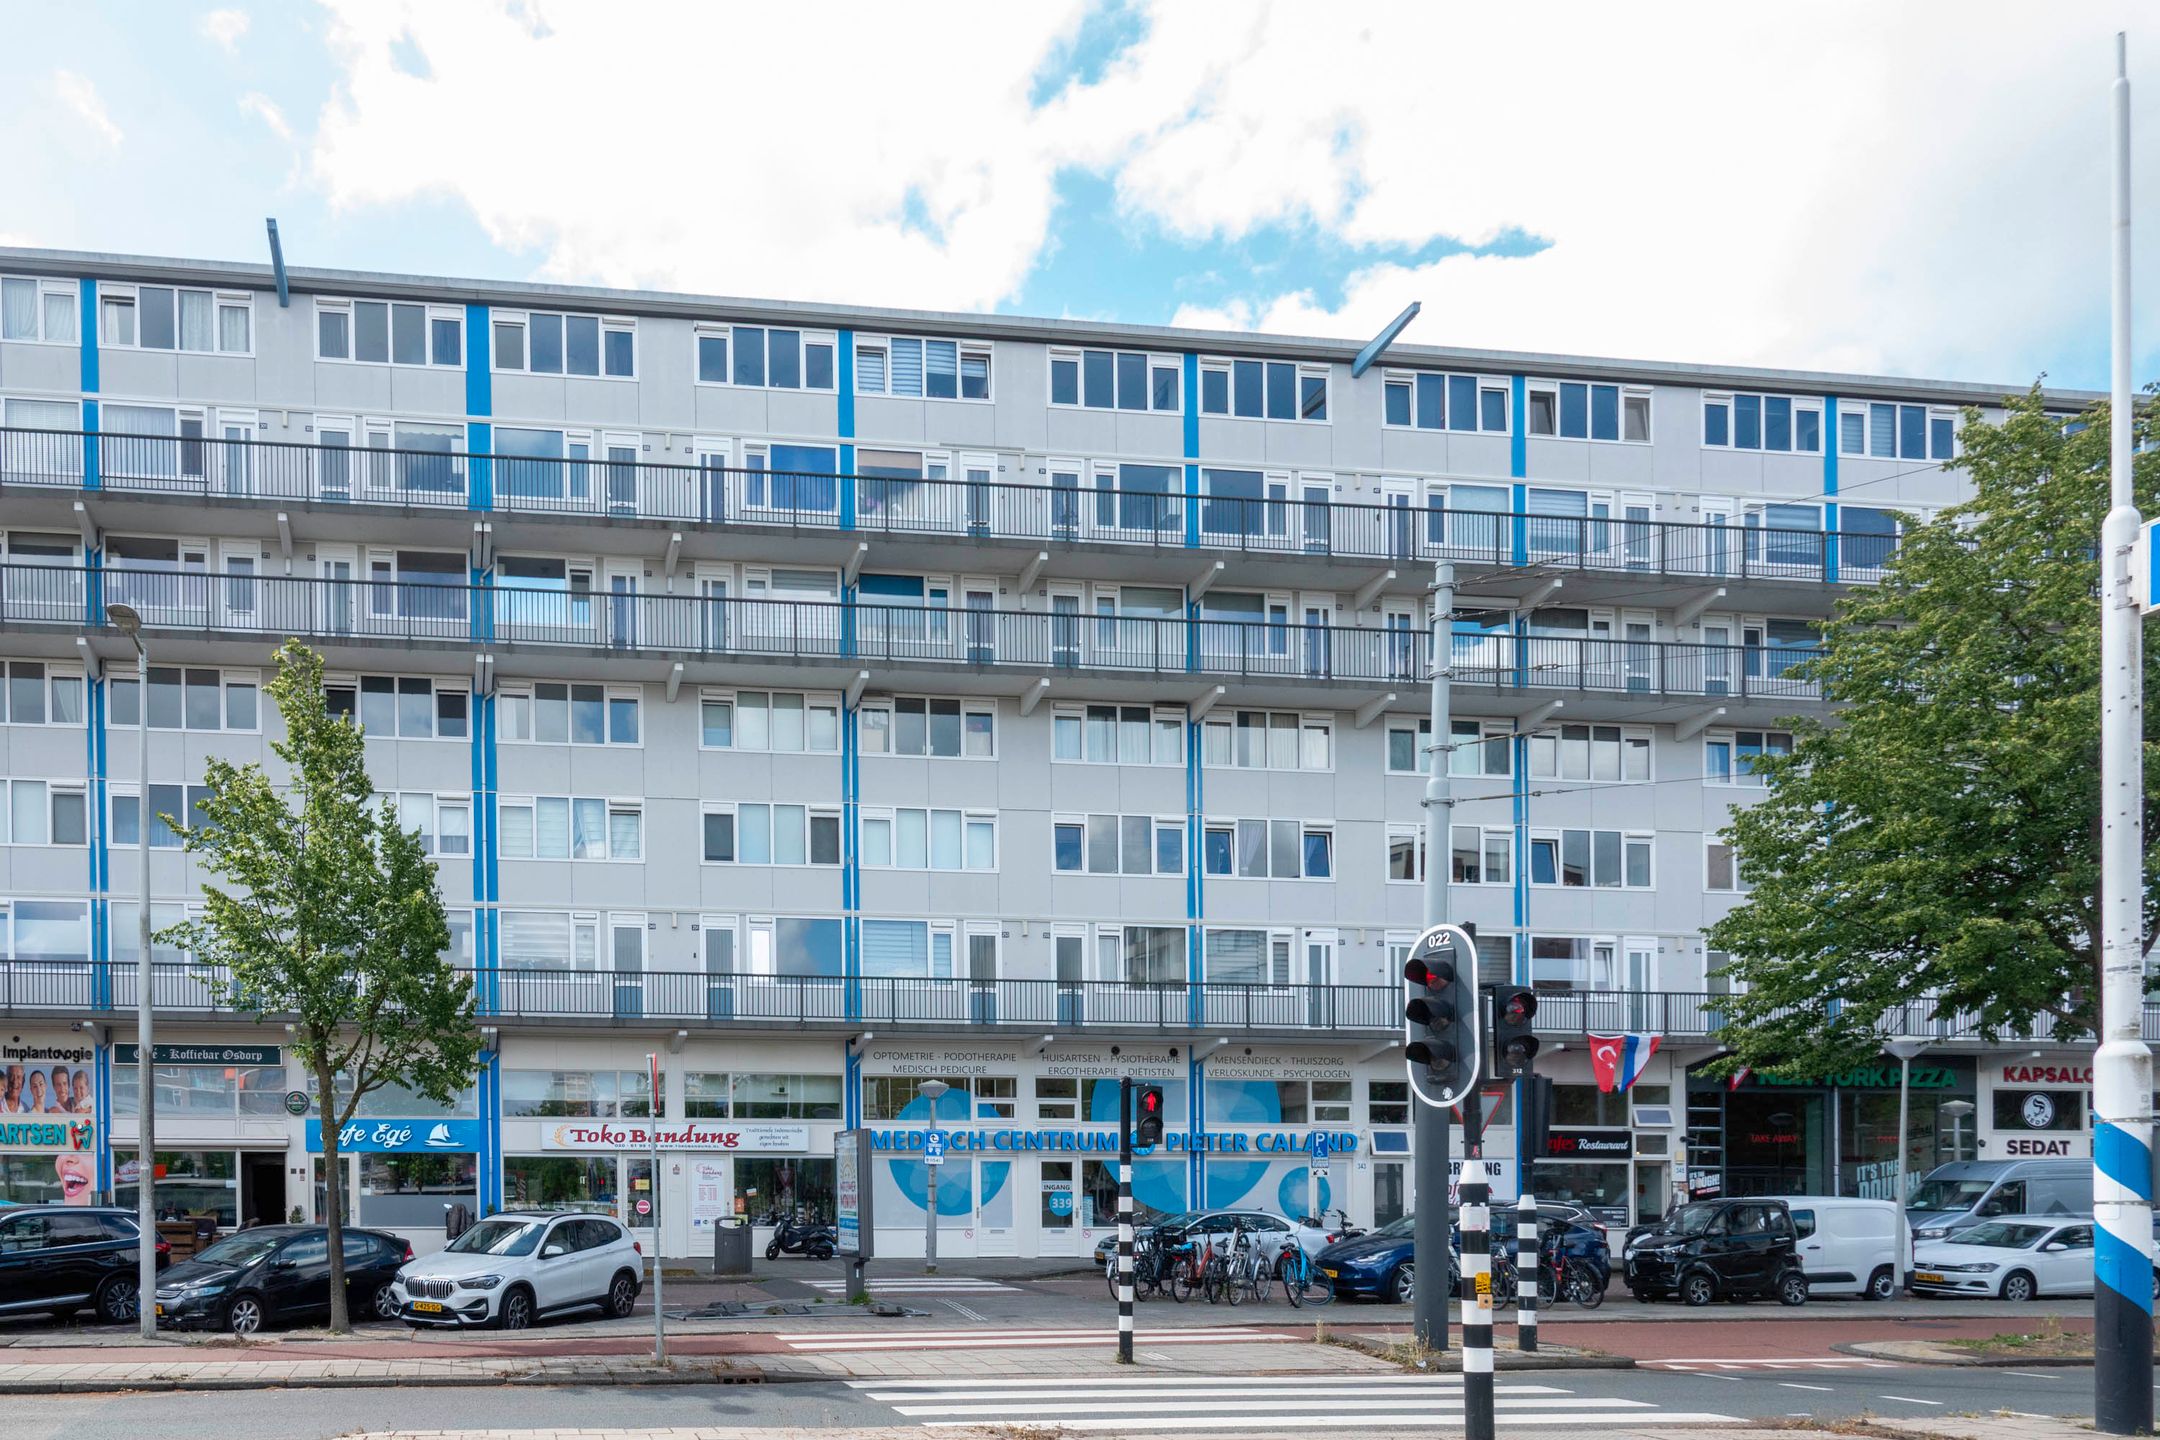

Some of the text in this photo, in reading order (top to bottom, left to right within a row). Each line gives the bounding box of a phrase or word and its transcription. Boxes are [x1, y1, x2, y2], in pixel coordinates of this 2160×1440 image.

[1428, 932, 1450, 948] 022
[169, 1049, 220, 1060] Koffiebar
[222, 1049, 263, 1062] Osdorp
[873, 1051, 934, 1061] OPTOMETRIE
[944, 1052, 1017, 1062] PODOTHERAPIE
[1042, 1054, 1100, 1063] HUISARTSEN
[1110, 1055, 1181, 1064] FYSIOTHERAPIE
[1215, 1056, 1281, 1065] MENSENDIECK
[1291, 1057, 1343, 1066] THUISZORG
[892, 1065, 987, 1074] MEDISCH PEDICURE
[1048, 1066, 1118, 1076] ERGOTHERAPIE
[1128, 1066, 1175, 1076] DIËTISTEN
[1208, 1068, 1274, 1078] VERLOSKUNDE
[1283, 1069, 1351, 1078] PSYCHOLOGEN
[2003, 1066, 2093, 1084] KAPSALO
[1889, 1066, 1957, 1088] PZZA
[2026, 1113, 2049, 1125] SEDAT
[371, 1122, 413, 1149] Egé
[570, 1124, 626, 1144] Toko
[993, 1130, 1118, 1151] CENTRUM
[1166, 1132, 1249, 1152] PIETER
[1578, 1138, 1629, 1150] Restaurant
[2006, 1139, 2071, 1156] SEDAT
[1856, 1163, 1878, 1182] IT'S
[1051, 1198, 1072, 1209] 339
